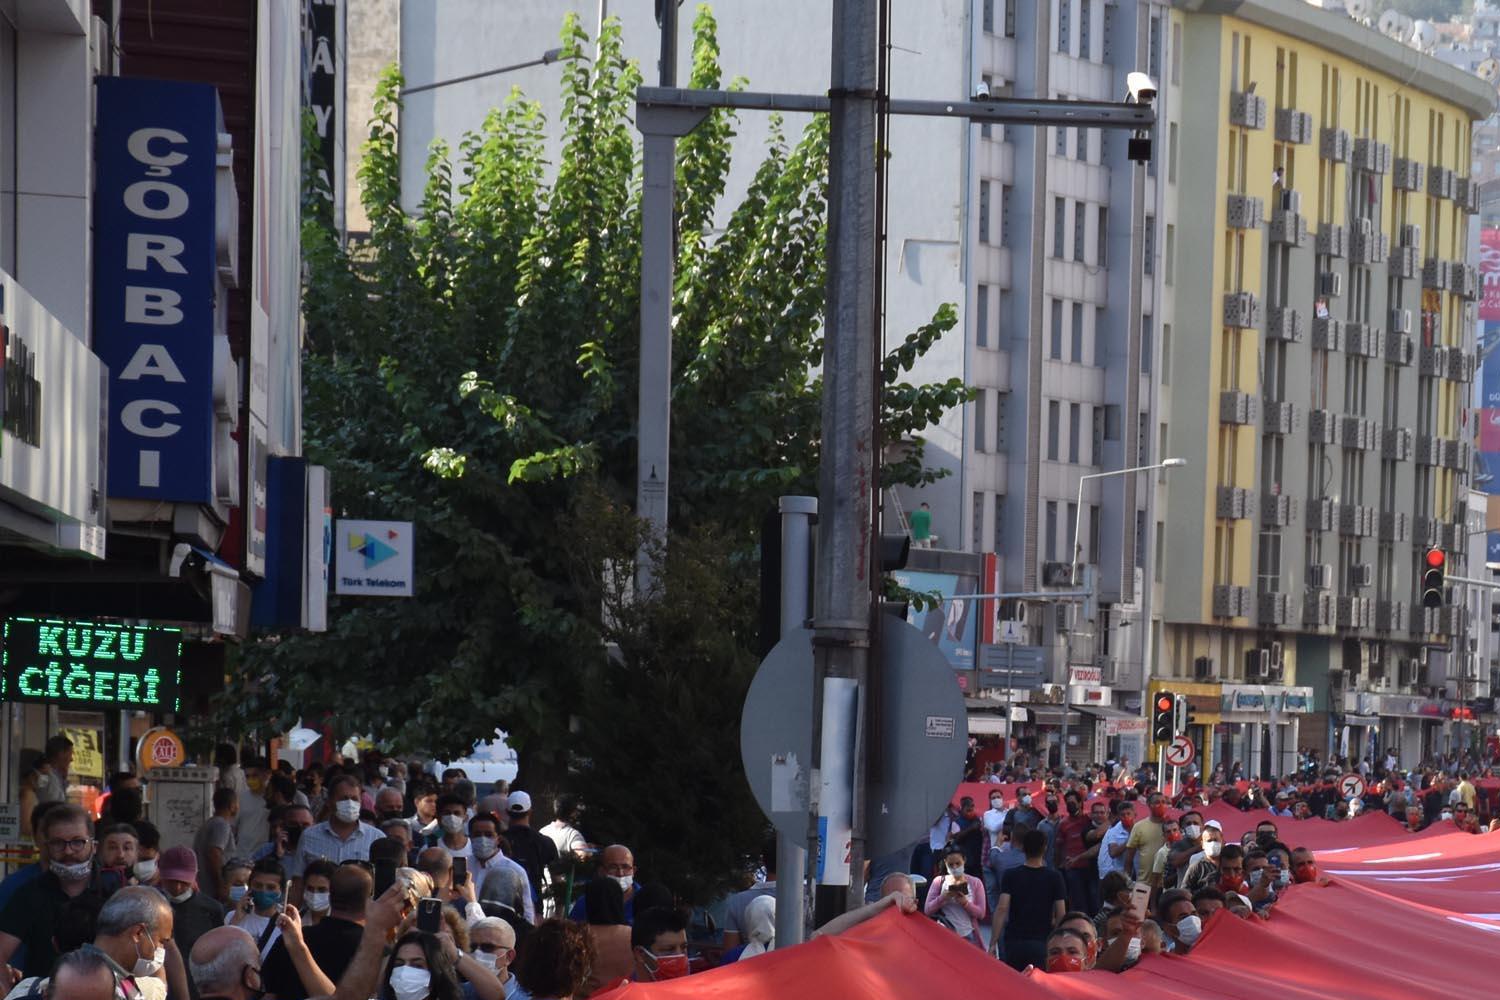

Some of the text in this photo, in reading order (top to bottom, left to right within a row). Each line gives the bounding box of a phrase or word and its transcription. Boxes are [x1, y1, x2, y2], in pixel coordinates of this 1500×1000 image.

[118, 127, 189, 488] ÇORBACI
[342, 577, 405, 588] Türk Telekom
[38, 626, 145, 661] KUZU
[18, 661, 161, 704] CİĞERİ
